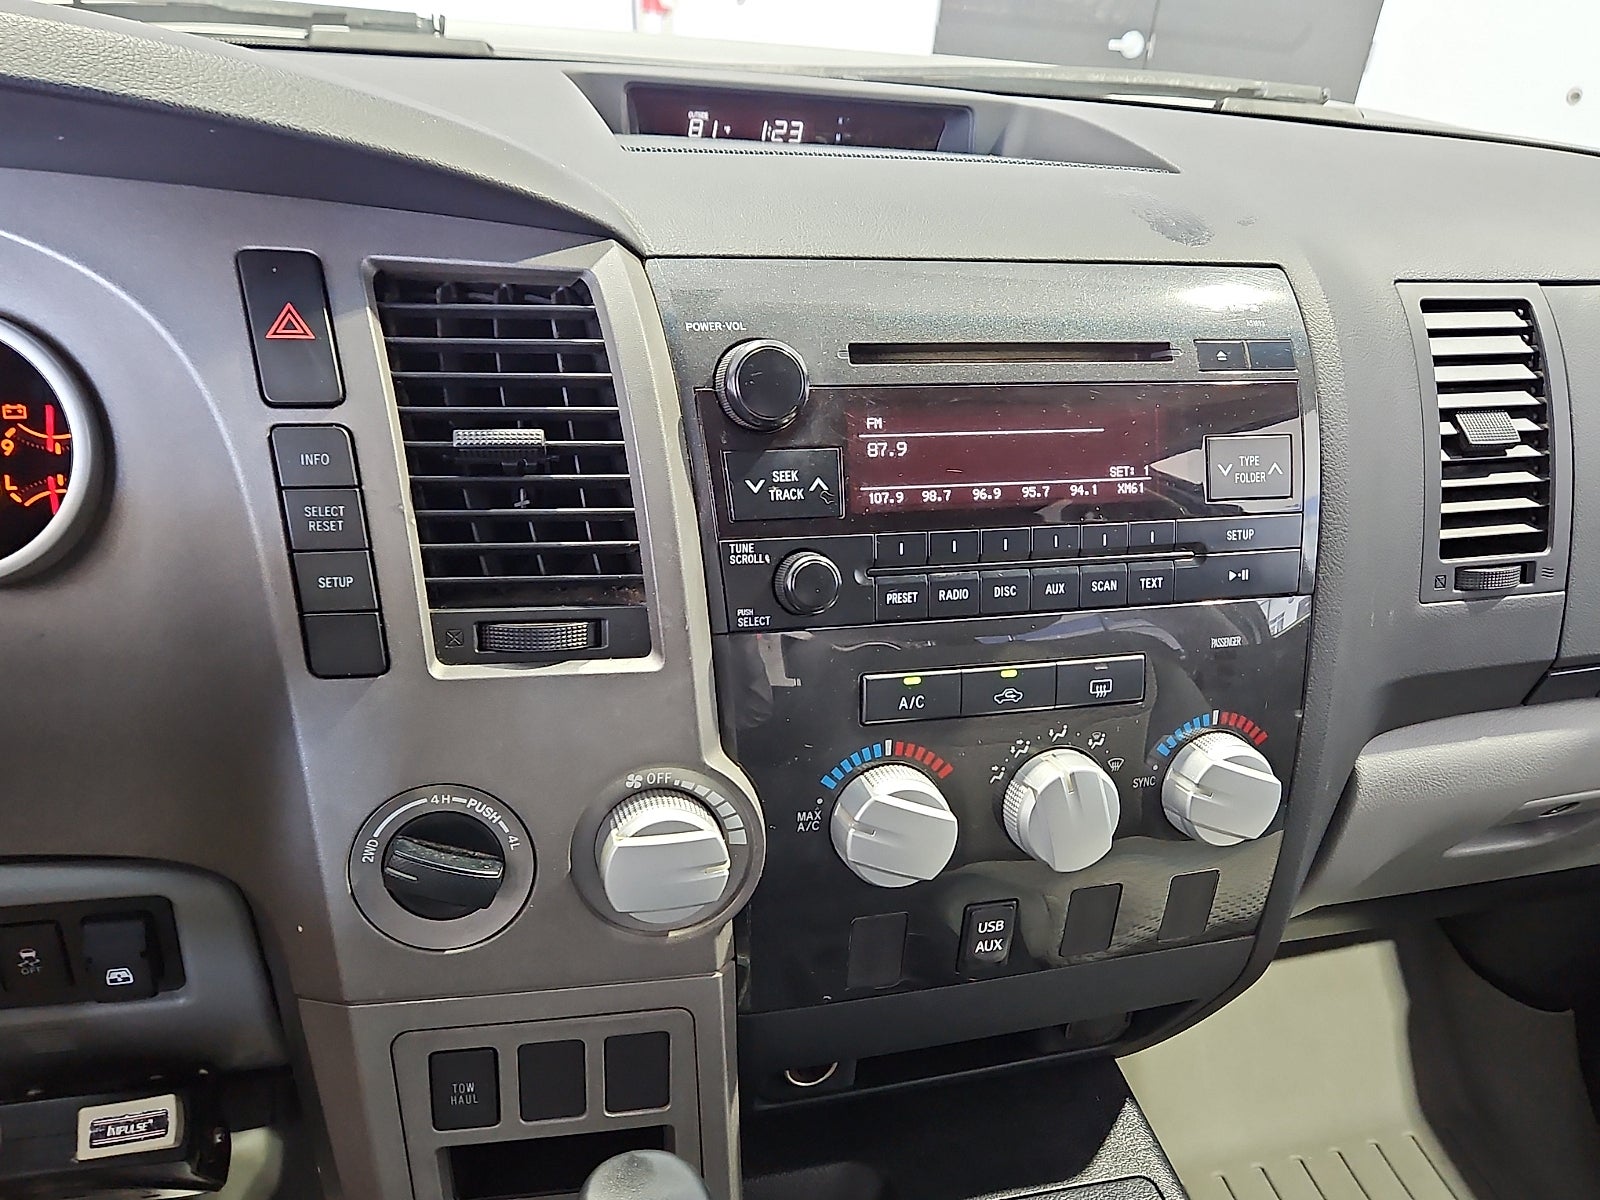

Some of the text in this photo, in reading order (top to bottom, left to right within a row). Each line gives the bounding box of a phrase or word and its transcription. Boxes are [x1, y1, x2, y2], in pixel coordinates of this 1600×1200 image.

[761, 119, 804, 143] 1:23
[866, 417, 883, 430] FM
[867, 441, 908, 458] 87.9
[300, 453, 330, 467] INFO
[1239, 455, 1260, 467] TYPE
[772, 470, 799, 482] SEEK
[1143, 465, 1149, 476] 1
[1235, 472, 1267, 485] FOLDER
[768, 488, 805, 501] TRACK
[868, 482, 1144, 504] 107.9 98.7 96.9 95.7 94.1 XM61
[304, 505, 345, 518] SELECT
[308, 521, 344, 532] RESET
[1226, 528, 1255, 541] SETUP
[729, 543, 755, 554] TUNE
[729, 554, 765, 565] SCROLL
[317, 576, 354, 589] SETUP
[1045, 582, 1065, 595] AUX
[1091, 579, 1118, 592] SCAN
[1139, 576, 1163, 590] TEXT
[886, 591, 918, 604] PRESET
[938, 588, 969, 601] RADIO
[994, 585, 1017, 598] DISC
[737, 608, 754, 617] PUSH
[737, 615, 771, 627] SELECT
[1210, 636, 1242, 649] PASSENGER
[898, 695, 925, 710] A/C
[646, 772, 672, 784] OFF
[1132, 776, 1156, 788] SYNC
[430, 794, 501, 824] 4H PUSH
[797, 810, 822, 821] MAX
[797, 820, 820, 832] A/C
[508, 834, 521, 850] 4L
[361, 839, 379, 863] 2WD
[977, 919, 1005, 933] USB
[975, 938, 1003, 954] AUX
[451, 1082, 475, 1094] TOW
[450, 1094, 478, 1106] HAUL
